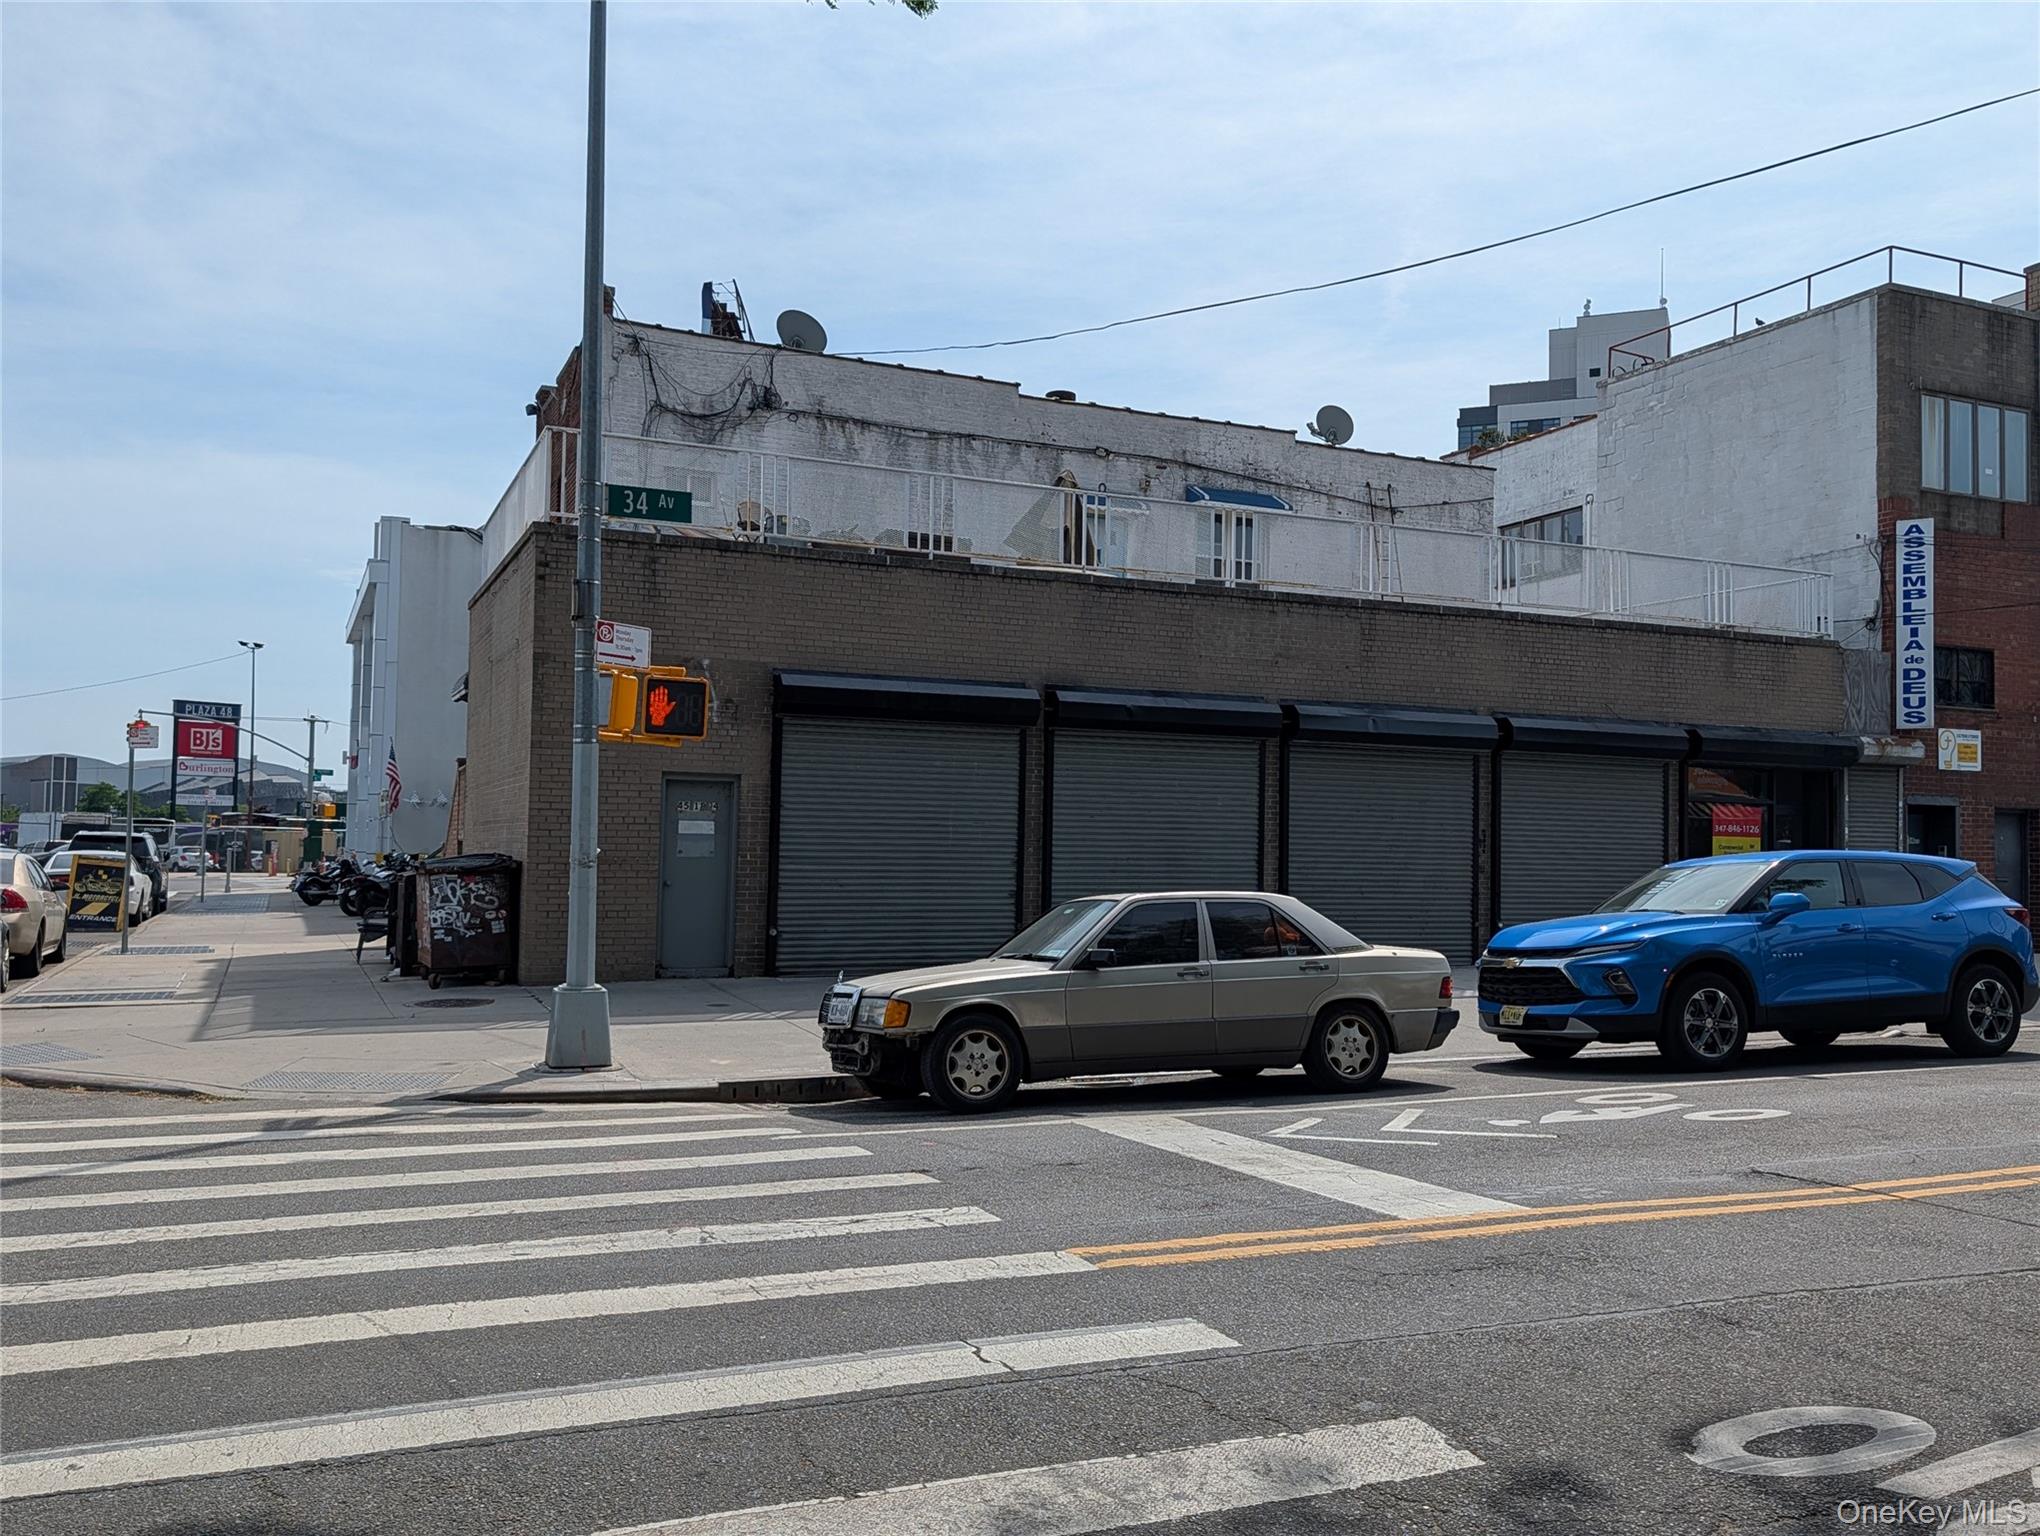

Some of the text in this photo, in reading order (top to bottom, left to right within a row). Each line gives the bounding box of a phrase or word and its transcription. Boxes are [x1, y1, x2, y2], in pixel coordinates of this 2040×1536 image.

[623, 490, 675, 515] 34 Av
[1903, 524, 1927, 651] ASSEMBLEIA
[1904, 655, 1925, 664] de
[1903, 668, 1927, 724] DEUS
[185, 703, 233, 718] PLAZA 48
[179, 761, 234, 774] Burlington
[69, 914, 118, 923] ENTRANCE
